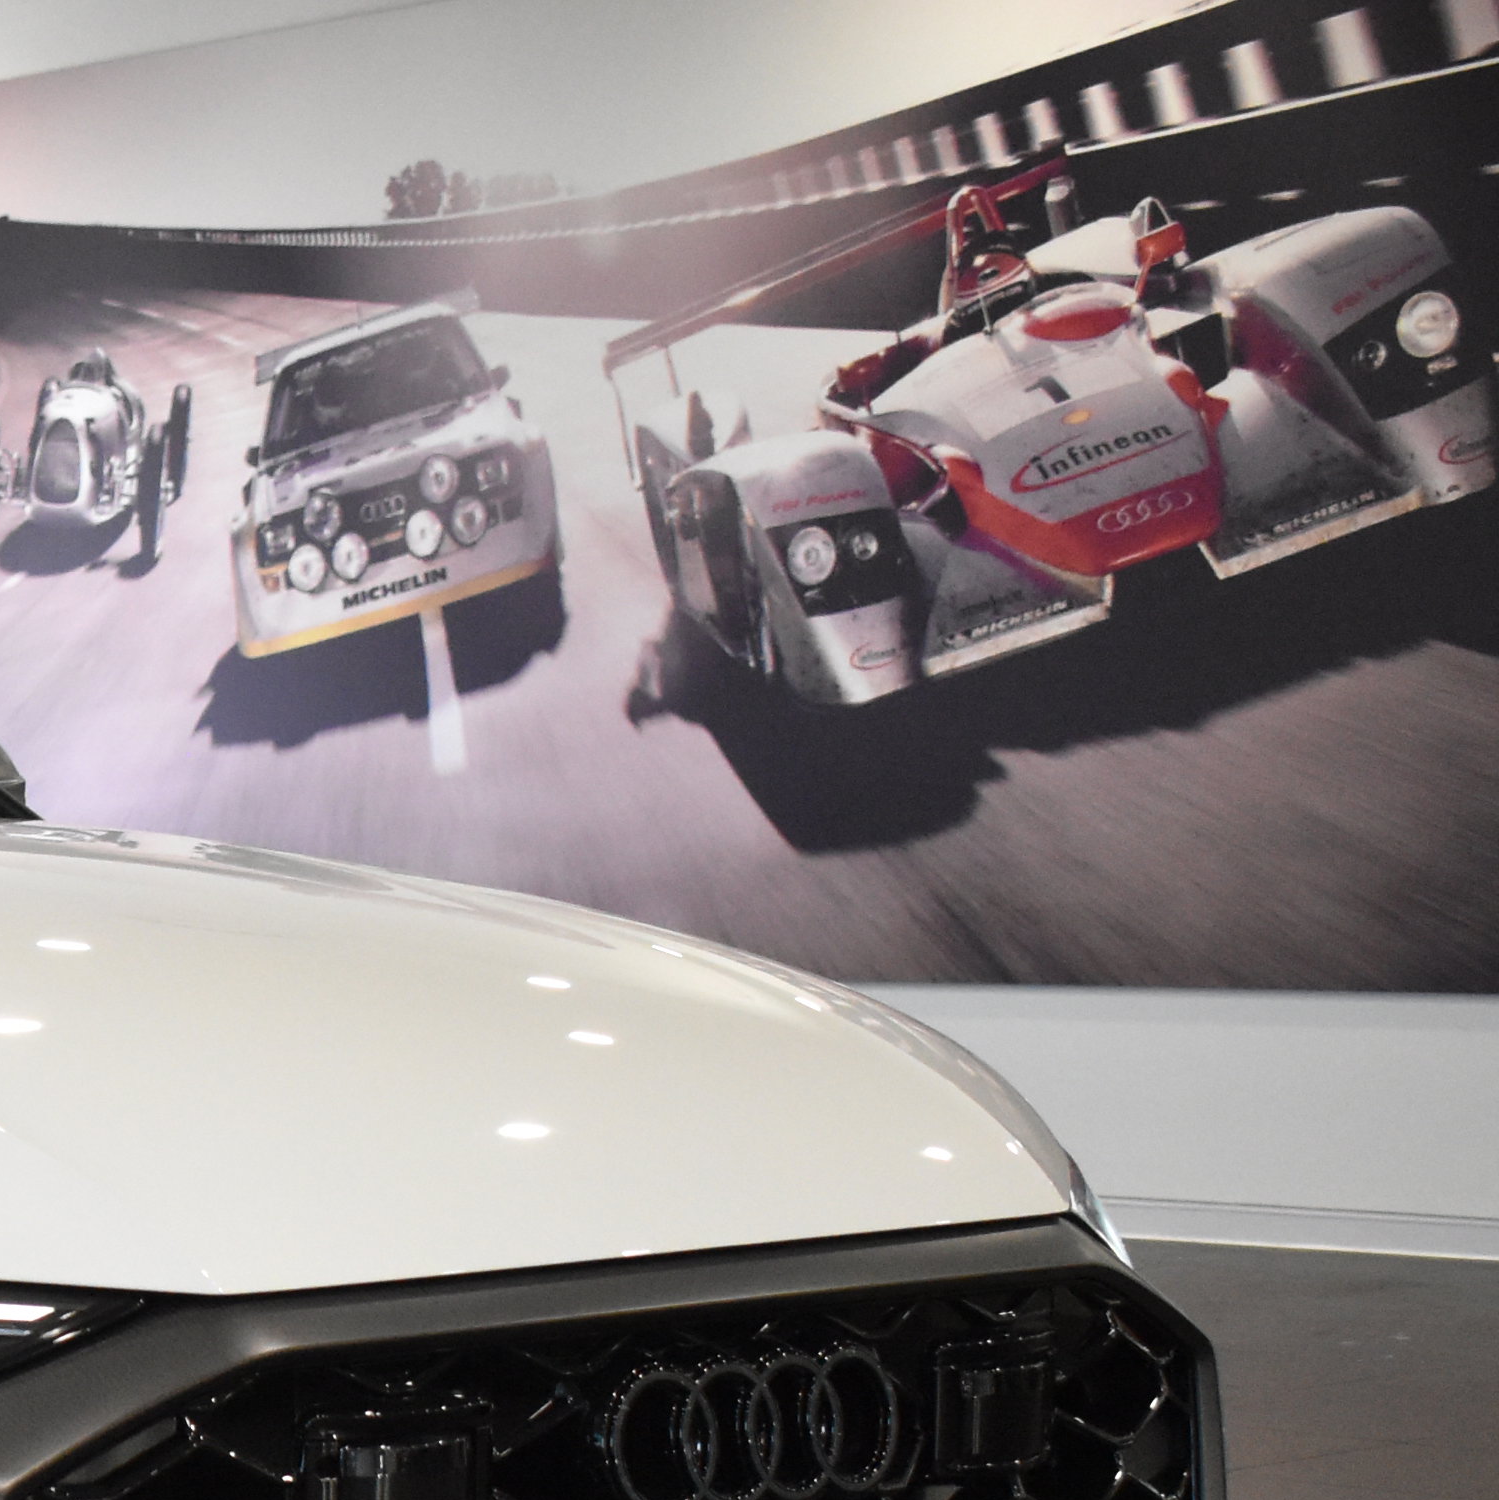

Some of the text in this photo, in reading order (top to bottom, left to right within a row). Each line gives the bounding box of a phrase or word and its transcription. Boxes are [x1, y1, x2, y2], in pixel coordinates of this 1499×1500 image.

[1023, 375, 1071, 403] 1
[1029, 424, 1173, 481] Infineon
[341, 566, 447, 610] MICHELIN
